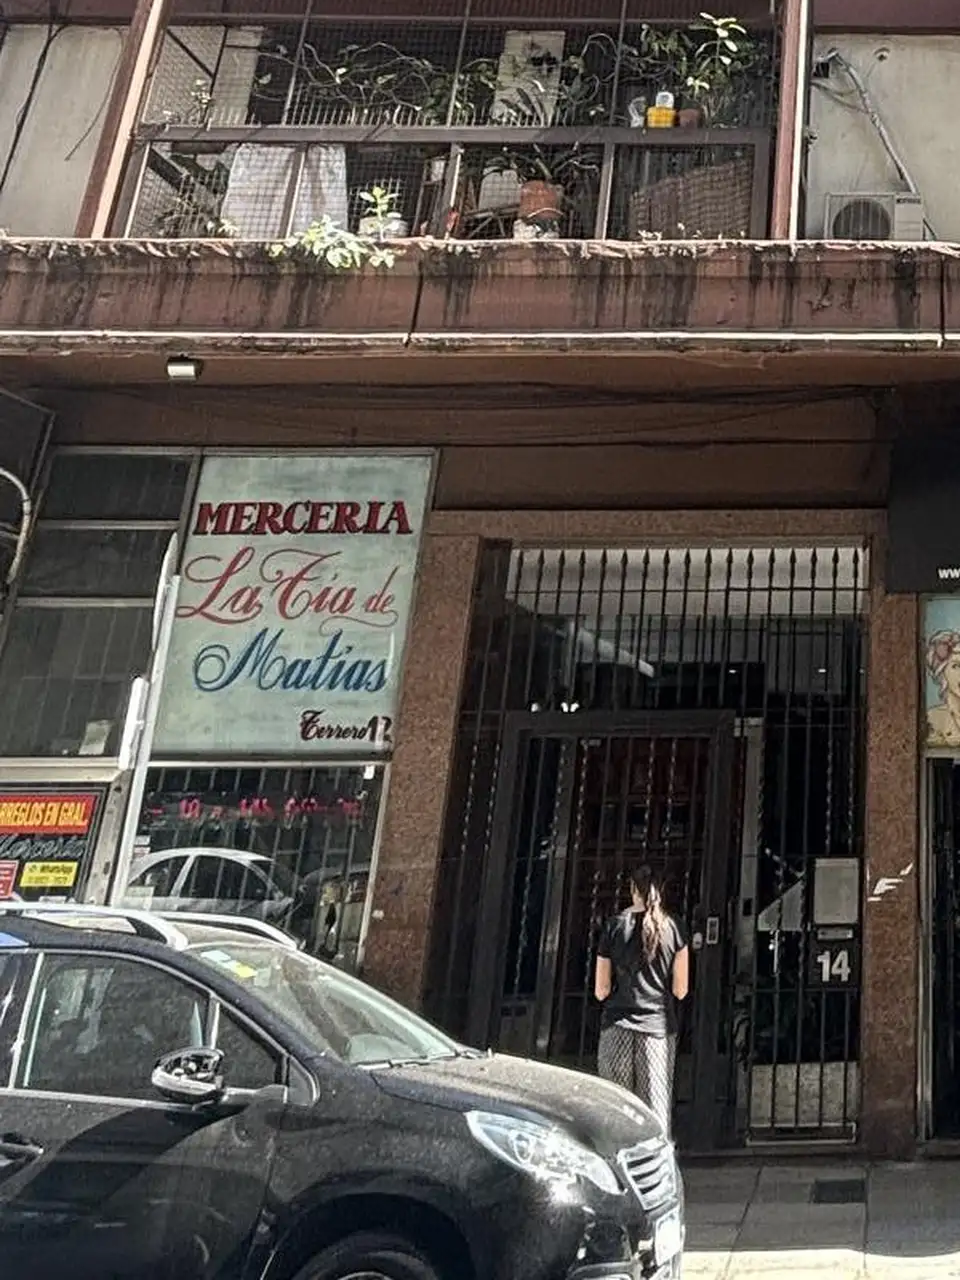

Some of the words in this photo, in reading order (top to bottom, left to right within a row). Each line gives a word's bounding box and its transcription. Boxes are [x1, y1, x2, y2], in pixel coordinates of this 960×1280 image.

[193, 500, 413, 536] MERCERIA
[175, 546, 264, 625] La
[300, 709, 366, 742] Terrero
[817, 949, 851, 983] 14
